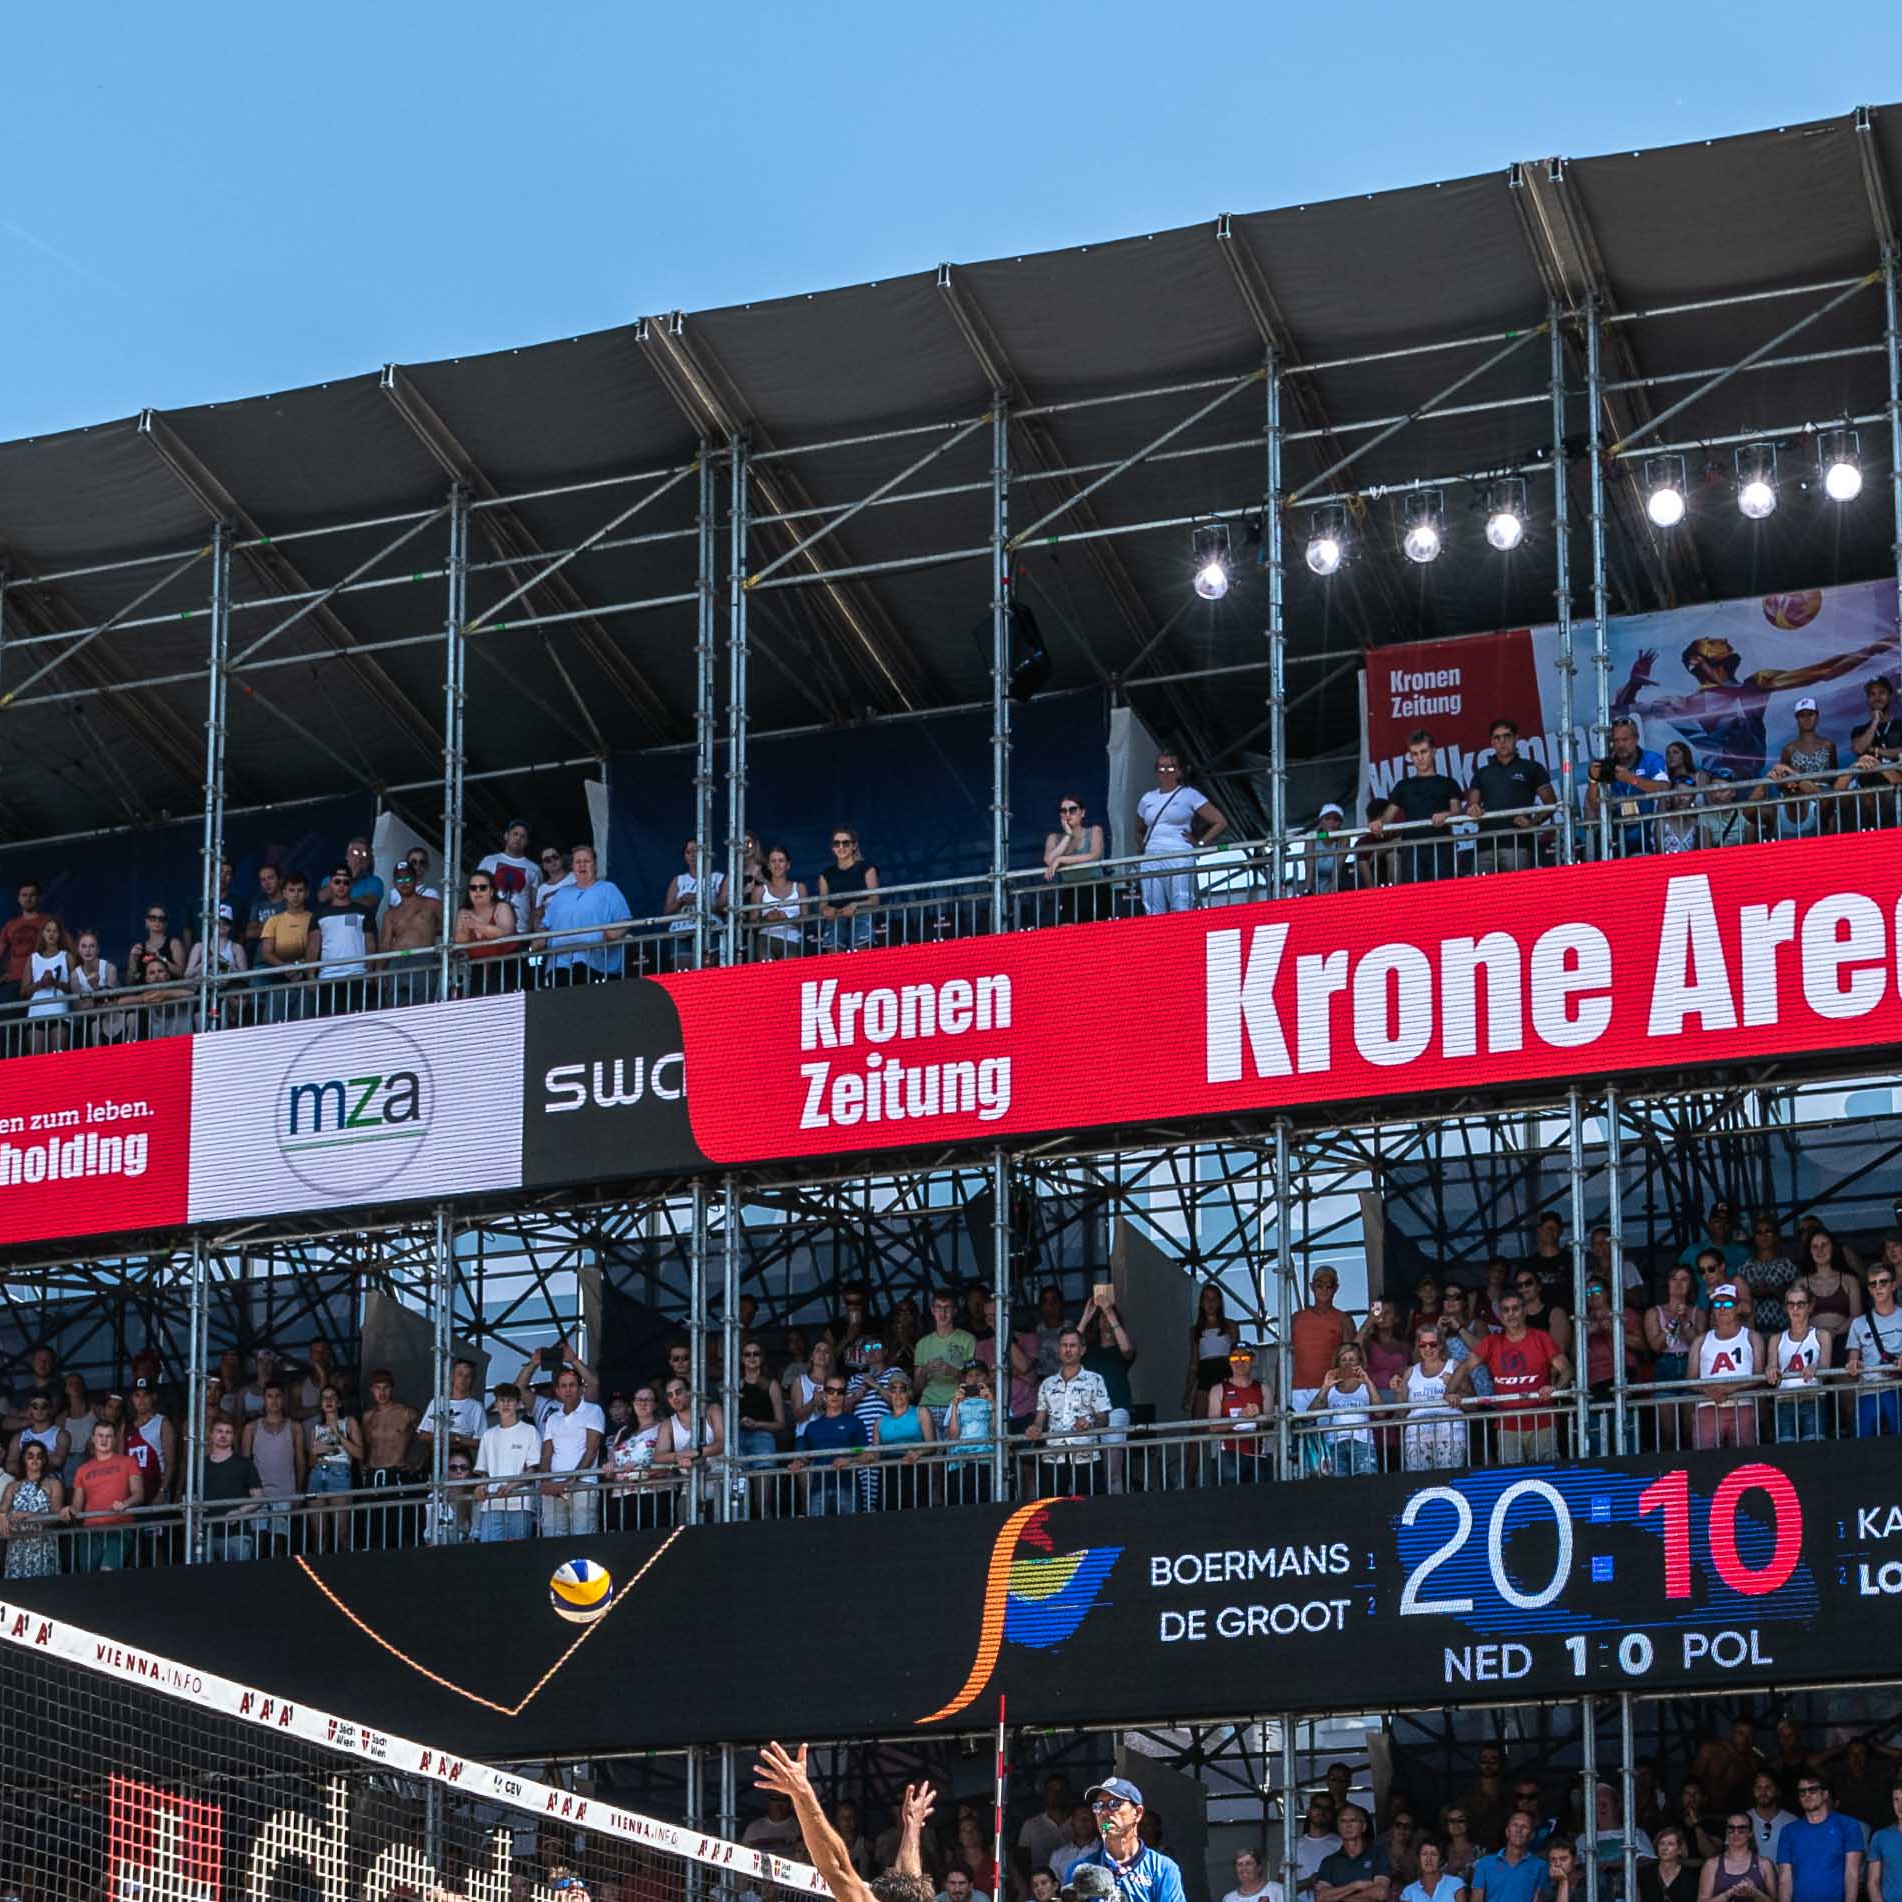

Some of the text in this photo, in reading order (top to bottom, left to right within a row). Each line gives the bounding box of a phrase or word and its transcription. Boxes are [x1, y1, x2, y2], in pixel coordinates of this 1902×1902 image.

[1389, 667, 1461, 694] Kronen
[1390, 693, 1462, 719] Zeitung
[800, 971, 1011, 1051] Kronen
[1206, 921, 1613, 1083] Krone
[289, 1071, 420, 1136] mza
[799, 1053, 1013, 1130] Zeitung
[29, 1109, 81, 1134] zum
[85, 1100, 155, 1127] leben.
[1711, 1346, 1743, 1376] A1
[1150, 1543, 1351, 1586] BOERMANS
[11, 1613, 29, 1637] A1
[35, 1621, 53, 1646] A1
[1160, 1611, 1206, 1641] DE
[1215, 1600, 1352, 1638] GROOT
[1444, 1629, 1773, 1683] NED 1 0 POL
[240, 1691, 294, 1727] A1 A1 A1
